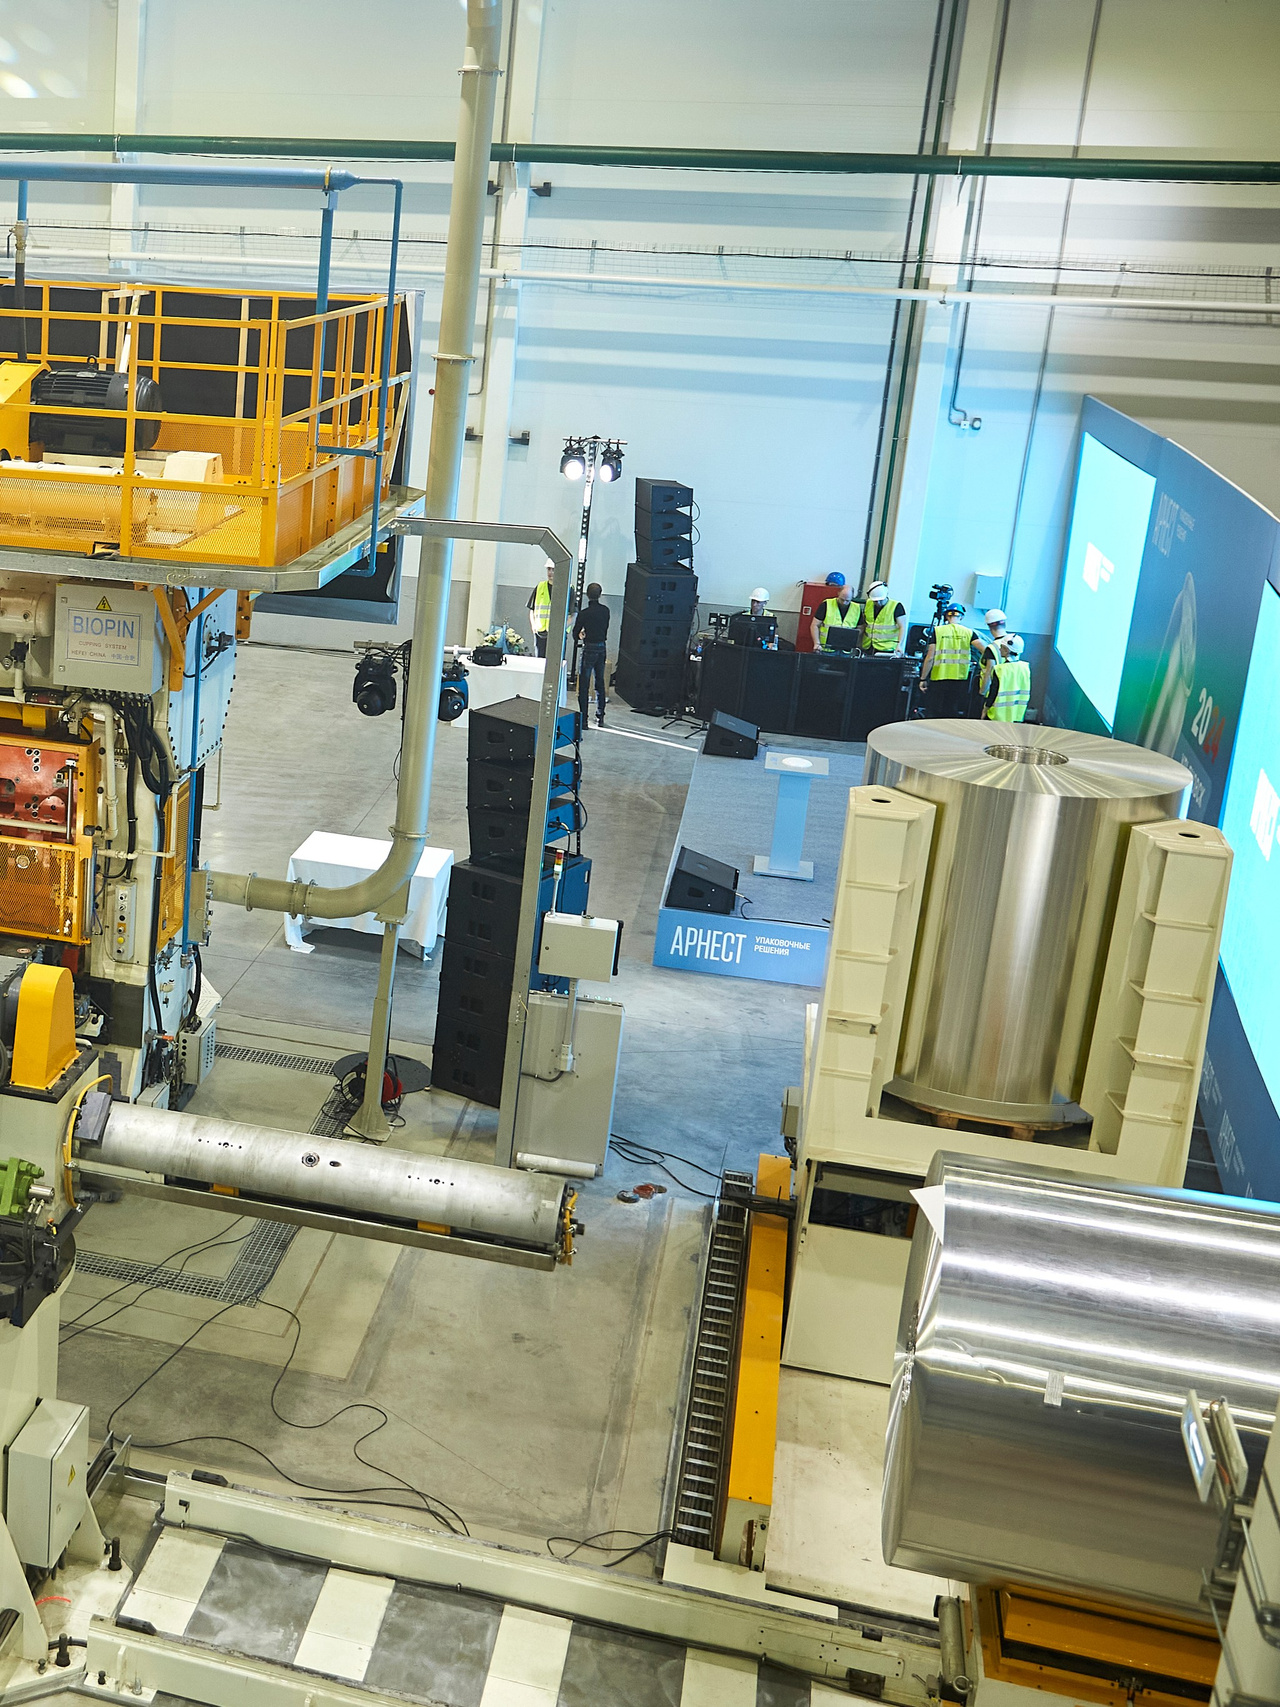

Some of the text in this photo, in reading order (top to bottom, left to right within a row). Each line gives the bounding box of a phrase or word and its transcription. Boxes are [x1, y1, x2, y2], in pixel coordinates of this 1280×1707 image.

[73, 616, 134, 638] BIOPIN
[669, 925, 747, 964] АРНЕСТ
[754, 944, 790, 956] РЕШЕНИЯ
[755, 935, 811, 951] УПАКОВОЧНЫЕ
